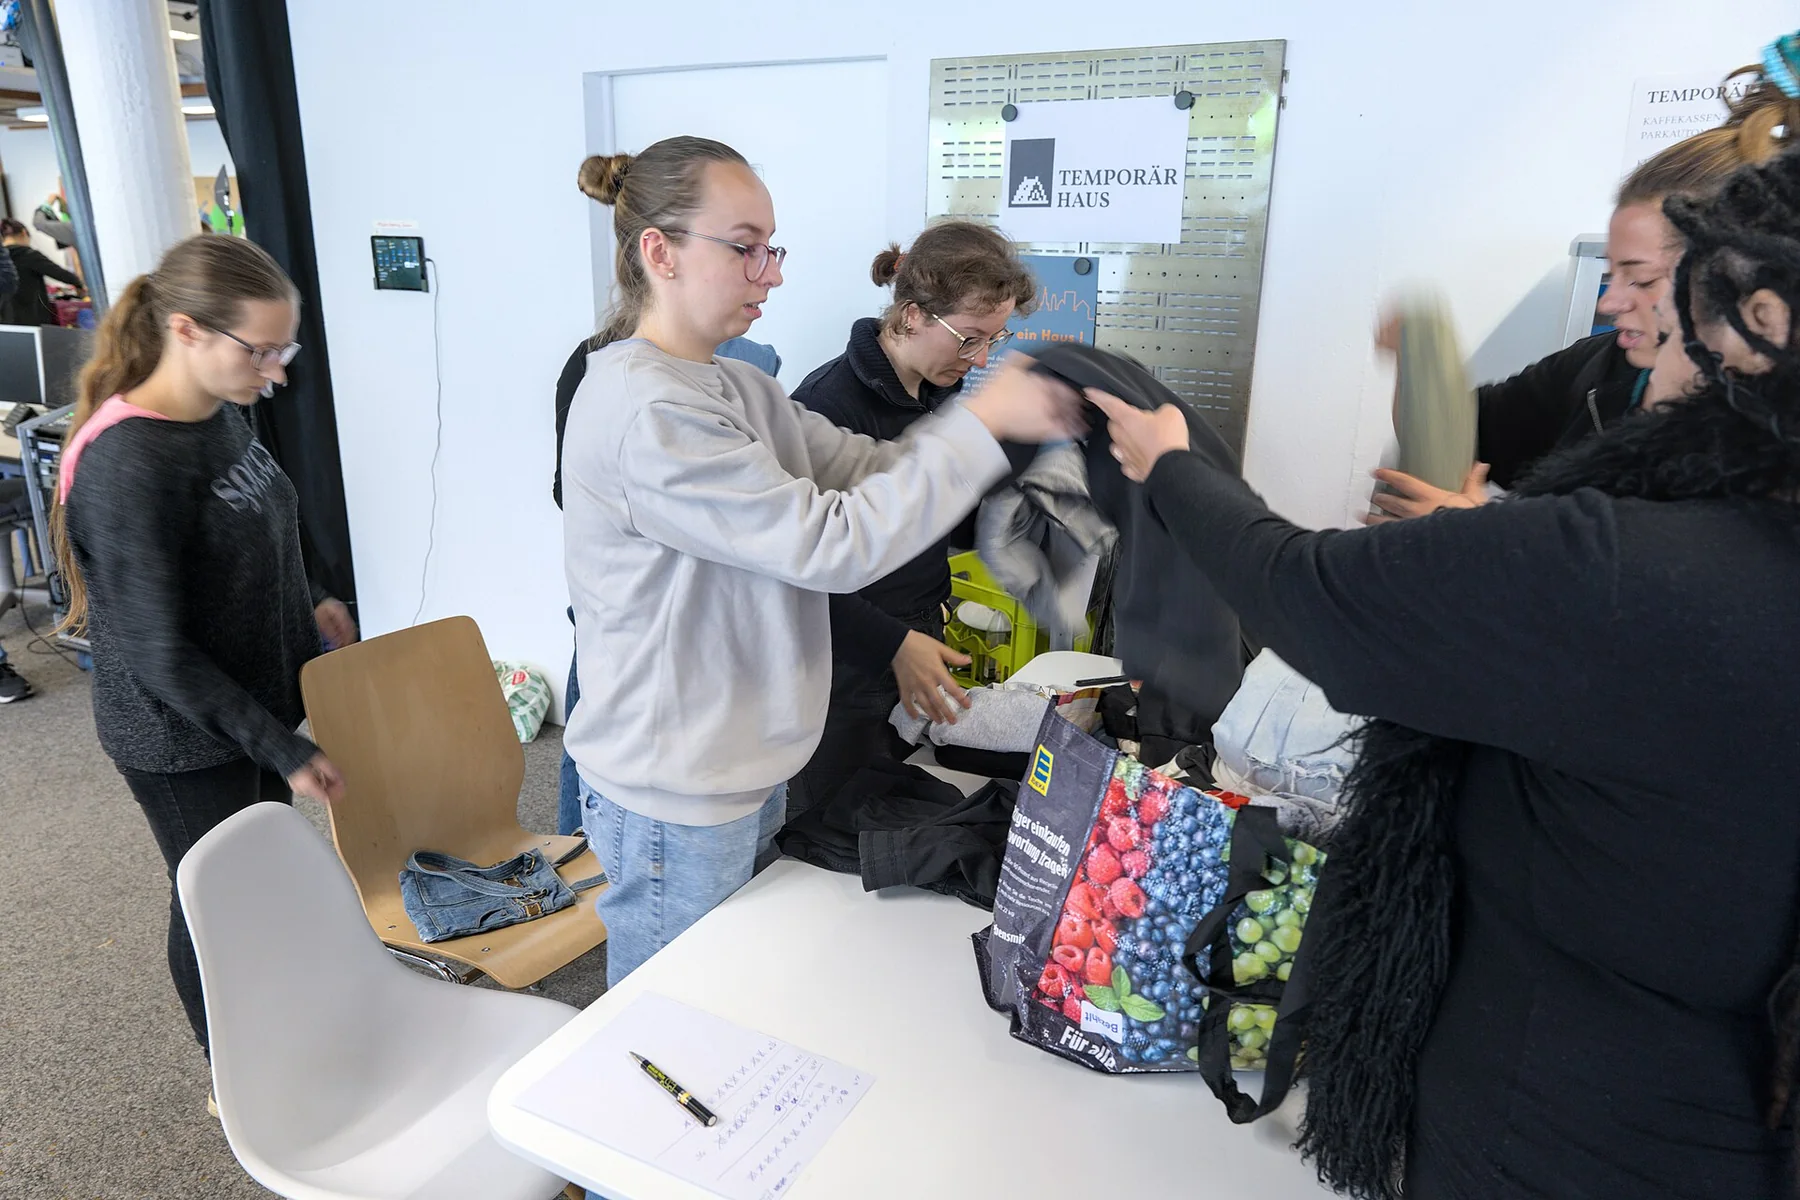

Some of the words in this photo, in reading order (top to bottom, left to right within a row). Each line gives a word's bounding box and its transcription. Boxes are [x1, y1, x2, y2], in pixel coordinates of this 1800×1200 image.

[1058, 164, 1178, 186] TEMPORÄR
[1057, 191, 1110, 208] HAUS
[1016, 327, 1038, 341] ein
[1041, 328, 1076, 343] Haus
[1030, 820, 1071, 857] einkaufen
[1084, 1011, 1119, 1034] Bezahlt
[1060, 1025, 1089, 1052] Für
[1087, 1043, 1117, 1071] alle
